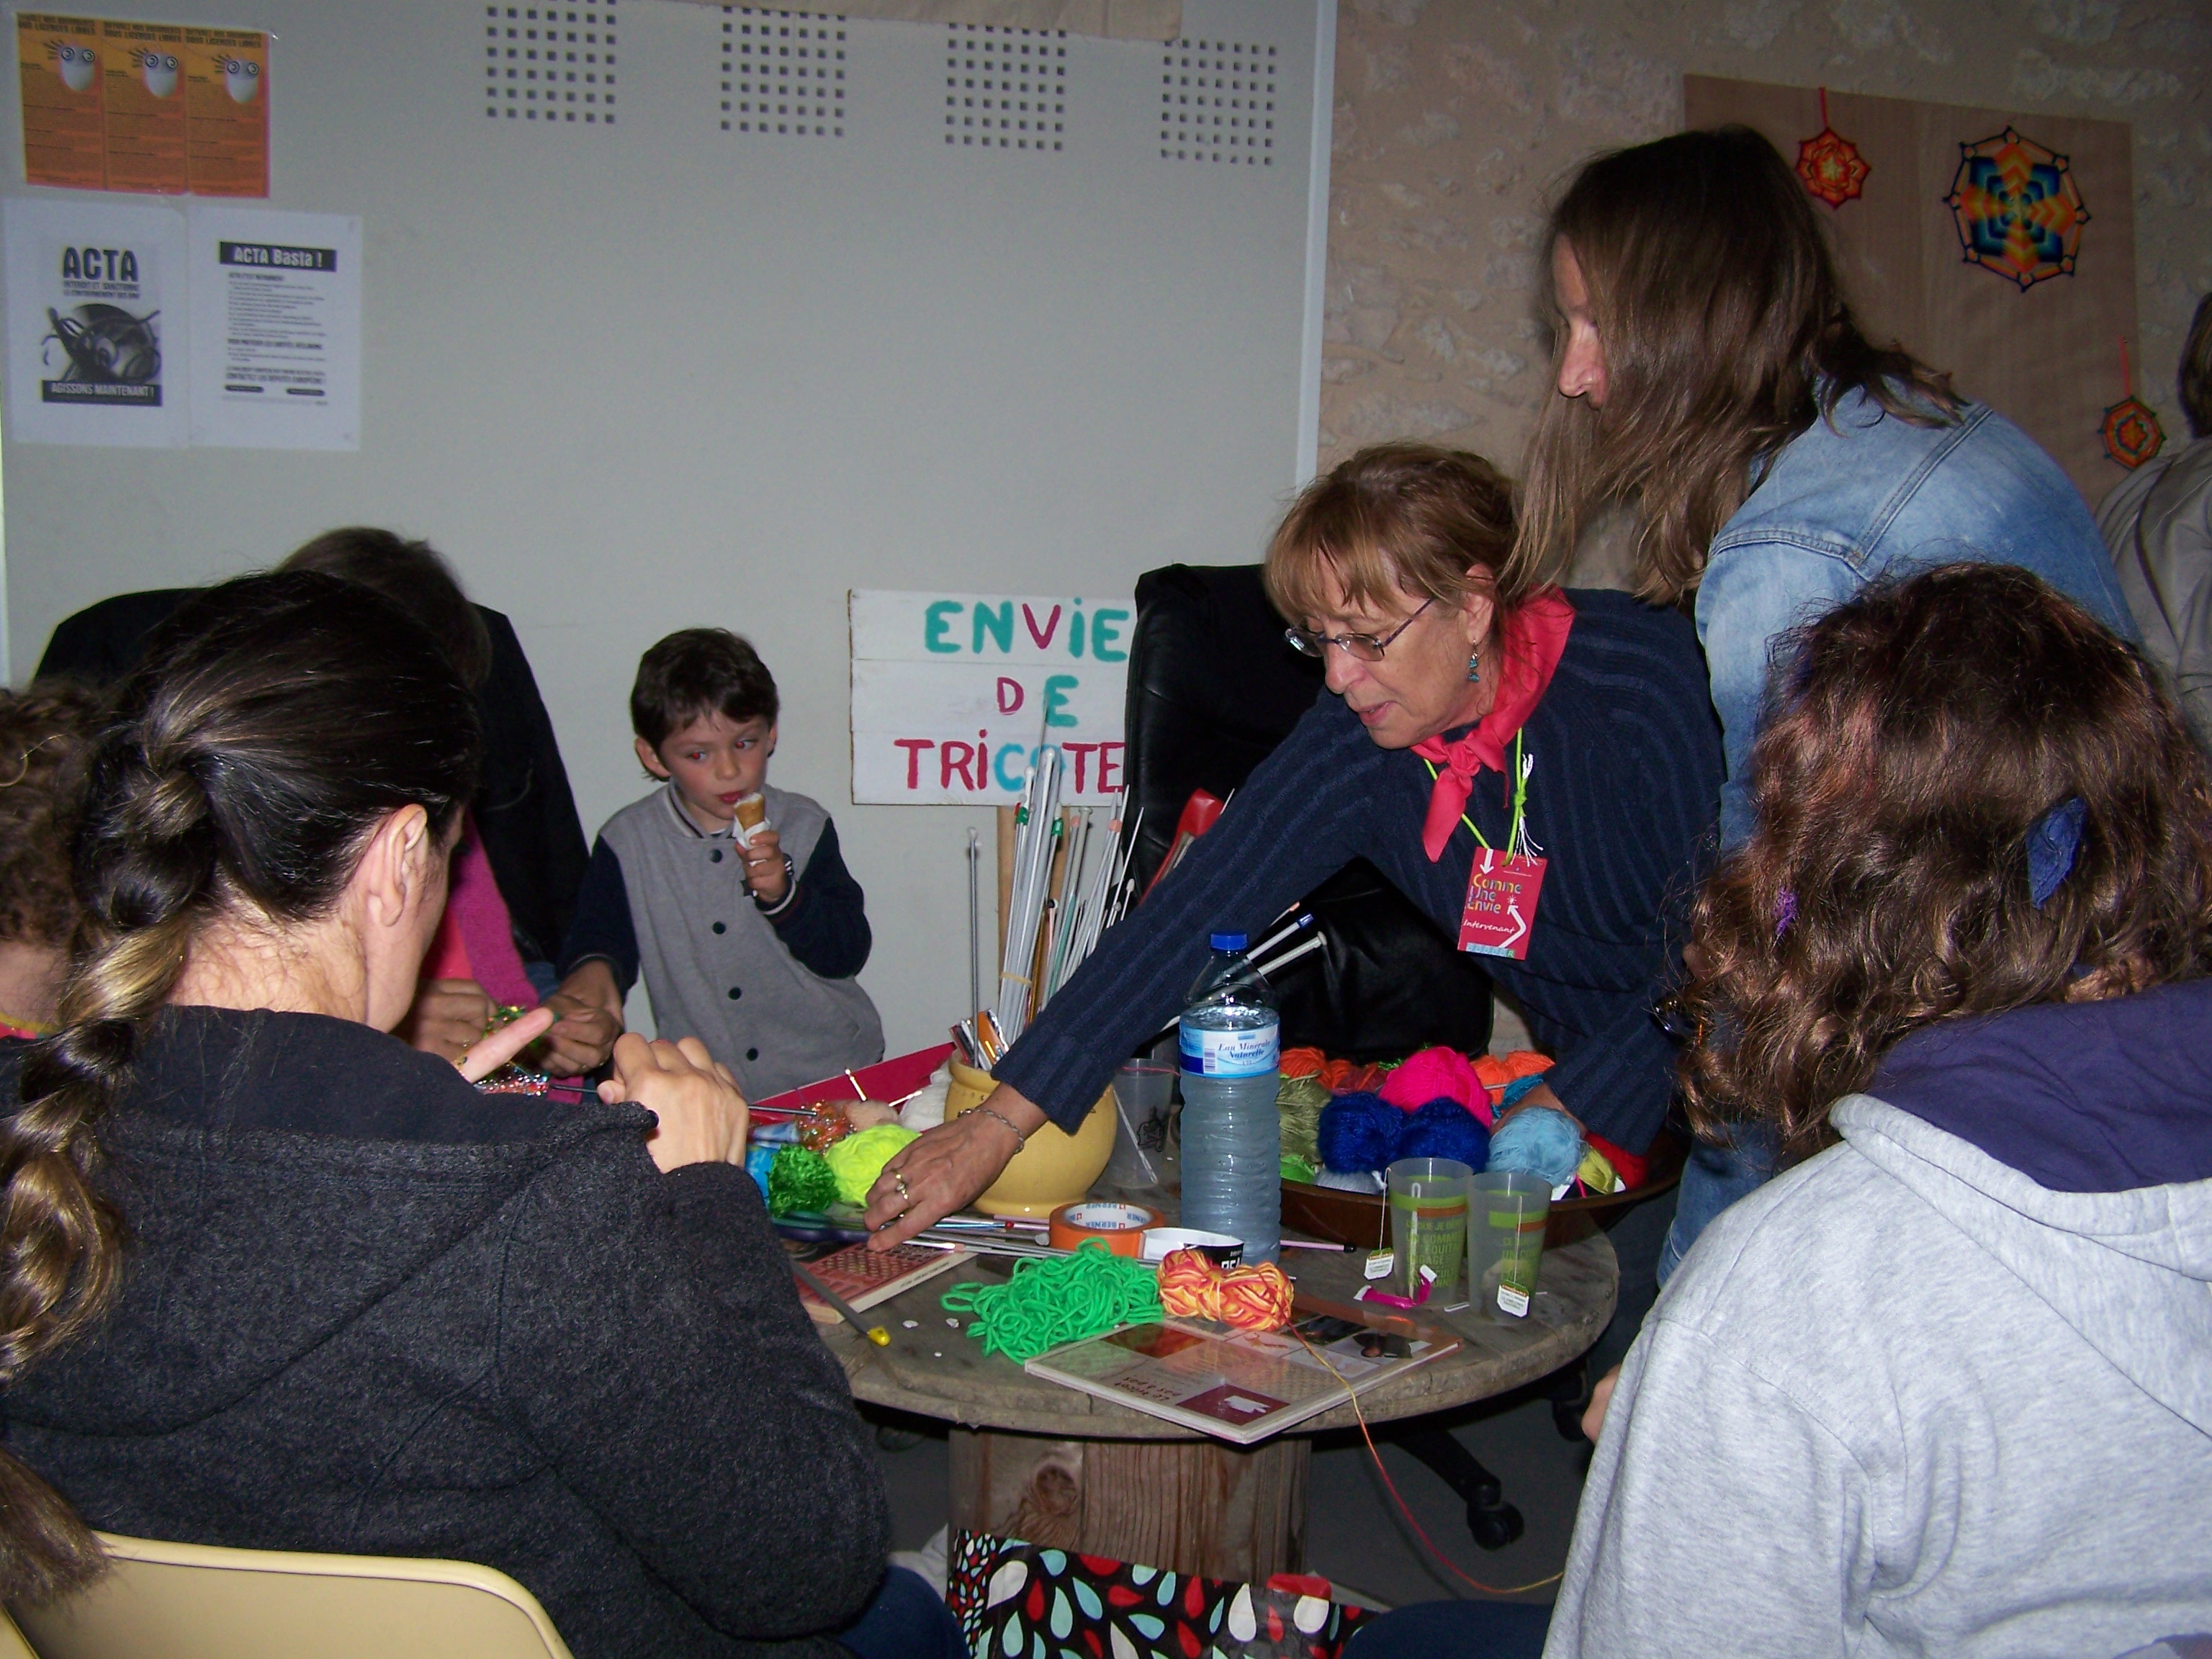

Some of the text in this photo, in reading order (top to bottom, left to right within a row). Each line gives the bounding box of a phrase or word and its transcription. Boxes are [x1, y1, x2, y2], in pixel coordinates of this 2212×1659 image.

[63, 247, 139, 282] ACTA
[234, 246, 269, 264] ACTA
[271, 248, 313, 267] Basta
[996, 675, 1079, 728] DE
[1469, 885, 1496, 902] Une
[1473, 873, 1522, 894] Comme
[1467, 896, 1502, 914] Envie
[1462, 919, 1515, 934] Intervenant
